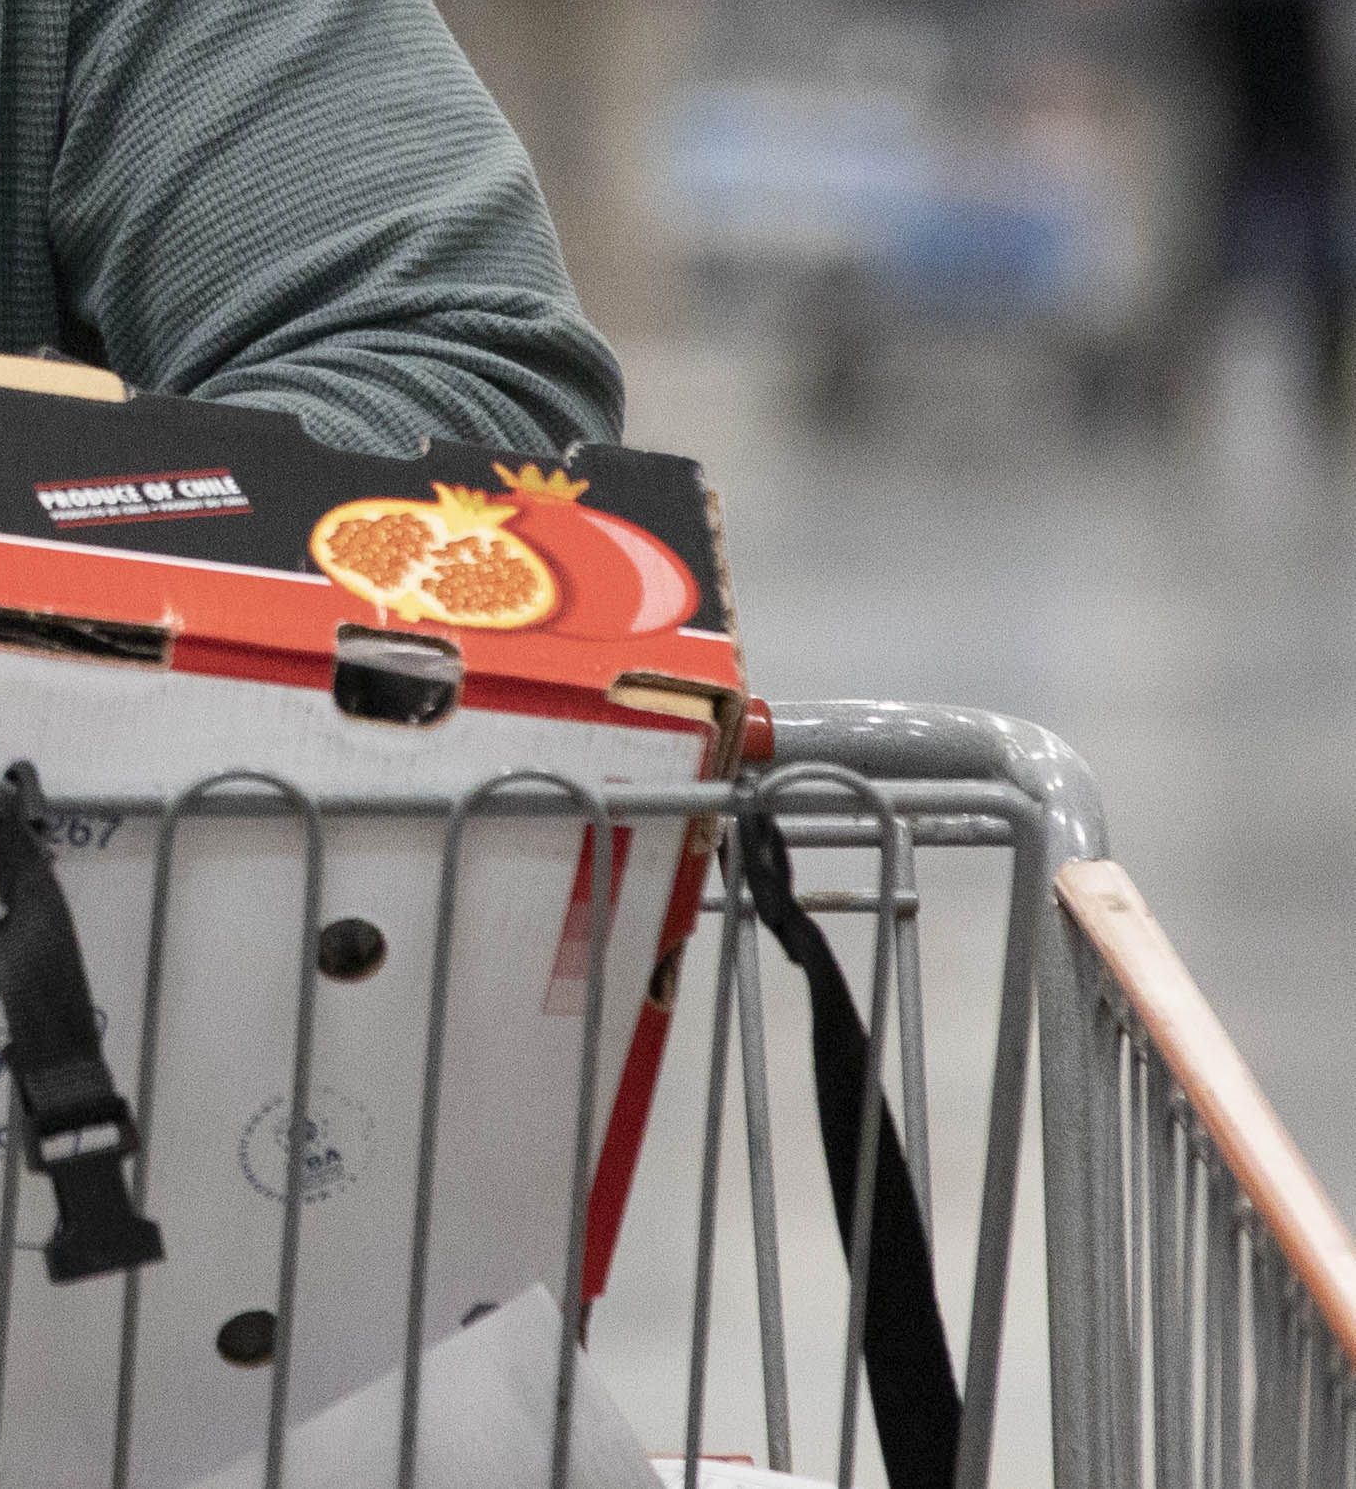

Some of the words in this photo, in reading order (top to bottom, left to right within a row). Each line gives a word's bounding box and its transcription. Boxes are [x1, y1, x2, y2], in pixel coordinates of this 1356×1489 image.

[38, 483, 143, 510] PRODUCE
[142, 480, 174, 502] OF
[176, 474, 242, 499] CHILE
